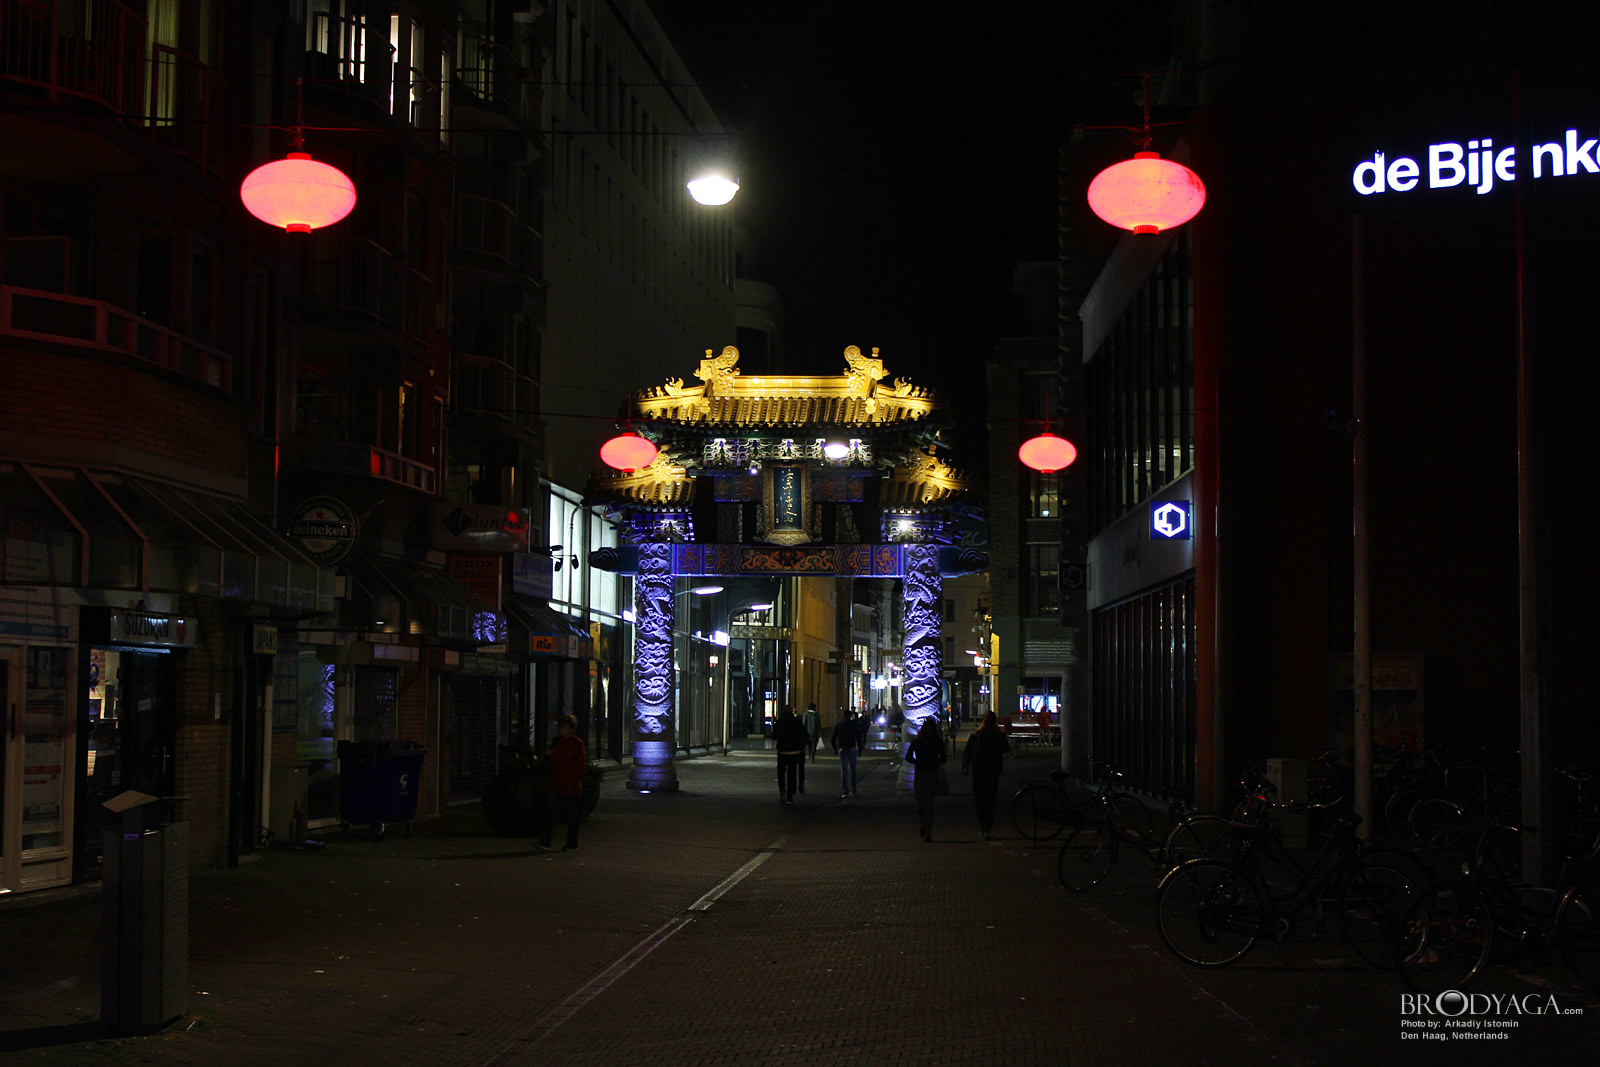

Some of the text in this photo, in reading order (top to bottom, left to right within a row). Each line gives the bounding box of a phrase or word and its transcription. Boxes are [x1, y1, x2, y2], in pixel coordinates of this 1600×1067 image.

[1352, 128, 1600, 195] de Bijenk
[294, 523, 348, 537] Heineken
[454, 560, 494, 569] EDOX
[454, 570, 494, 579] SEIKO
[124, 612, 169, 639] SUZURAN
[536, 638, 552, 650] Ria
